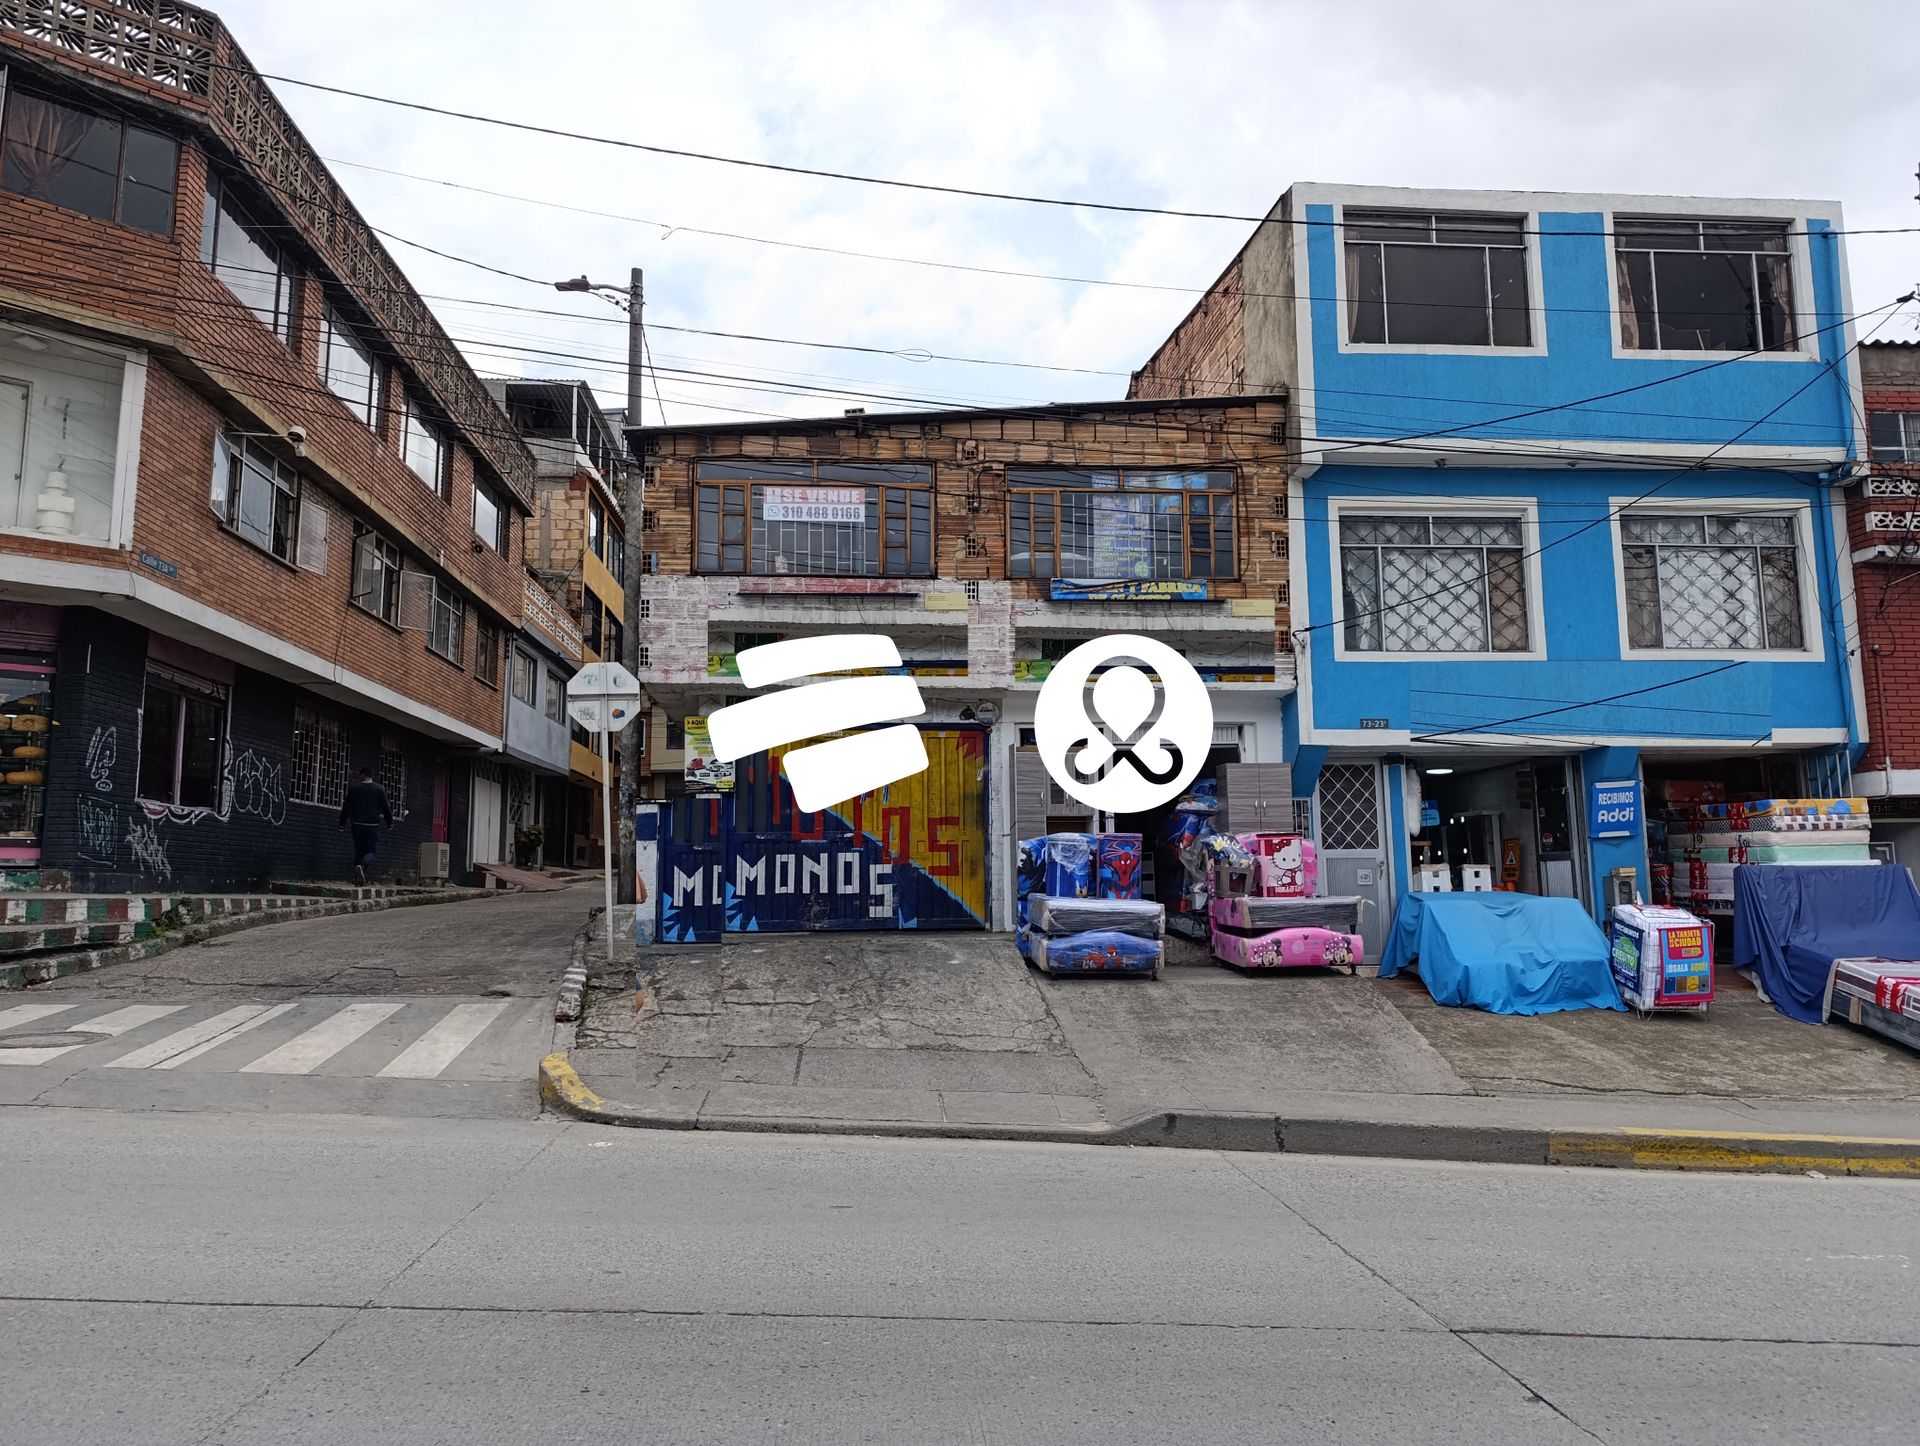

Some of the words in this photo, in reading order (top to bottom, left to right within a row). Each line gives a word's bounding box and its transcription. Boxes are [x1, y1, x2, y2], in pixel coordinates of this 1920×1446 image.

[782, 489, 802, 503] SE
[806, 489, 860, 503] VENDE
[782, 505, 803, 519] 310
[806, 506, 828, 519] 488
[831, 507, 860, 520] 0166
[142, 553, 158, 569] Calle
[1361, 720, 1385, 728] 73-23
[1598, 791, 1634, 805] RECIBIMOS
[1597, 807, 1635, 824] Addi
[736, 852, 893, 918] MONOS
[1668, 931, 1676, 939] LA
[1677, 929, 1701, 938] TARJETA
[1675, 937, 1702, 947] CIUDAD
